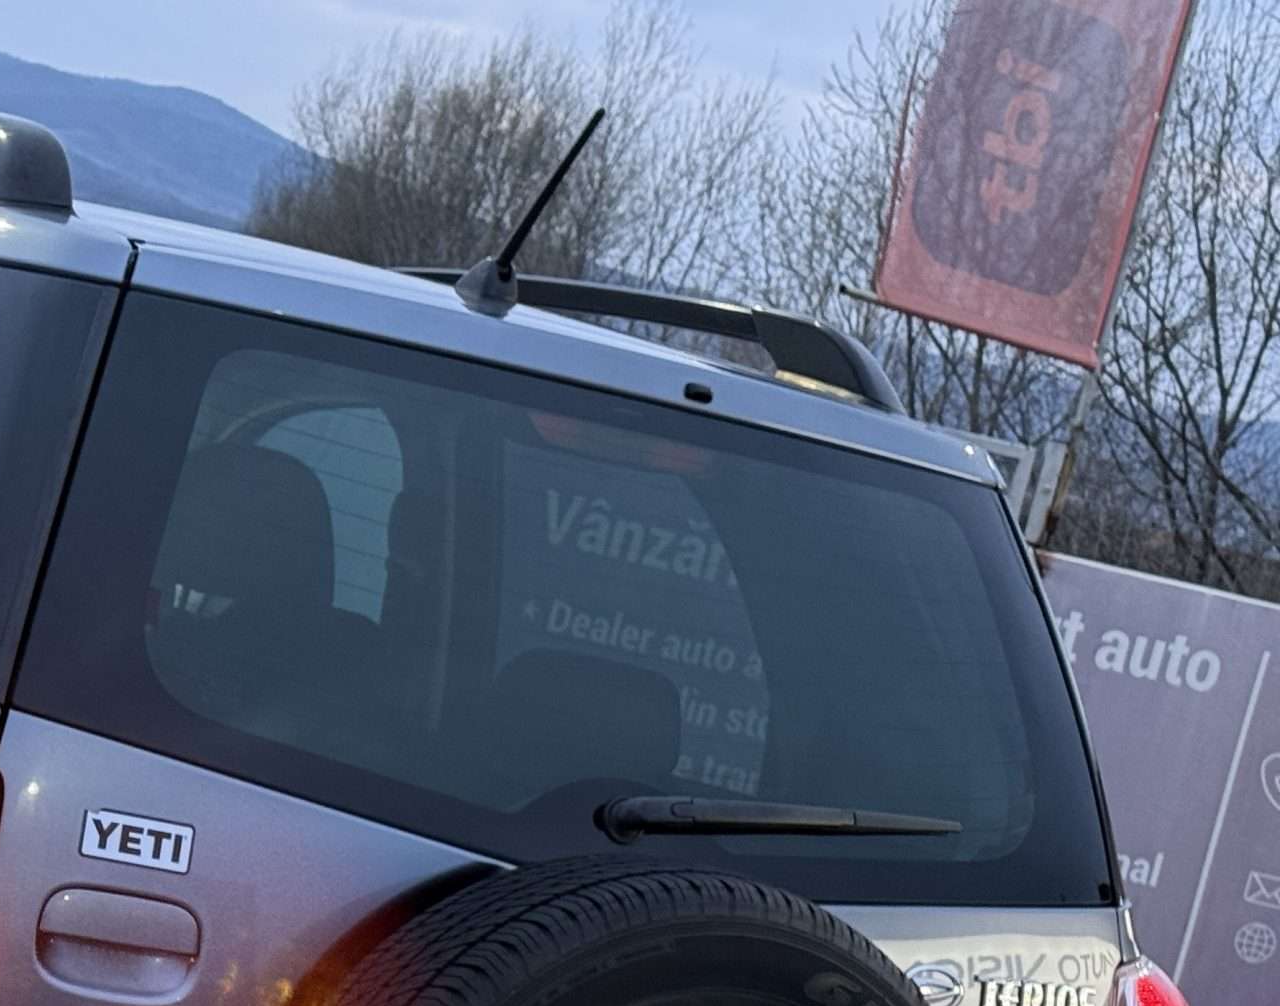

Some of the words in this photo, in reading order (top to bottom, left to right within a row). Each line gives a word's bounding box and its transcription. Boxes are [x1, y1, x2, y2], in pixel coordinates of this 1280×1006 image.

[980, 48, 1061, 225] tbi
[545, 488, 739, 587] Vânzăr
[547, 599, 655, 653] Dealer
[661, 634, 736, 672] auto
[1095, 630, 1220, 692] auto
[92, 818, 183, 864] YETI
